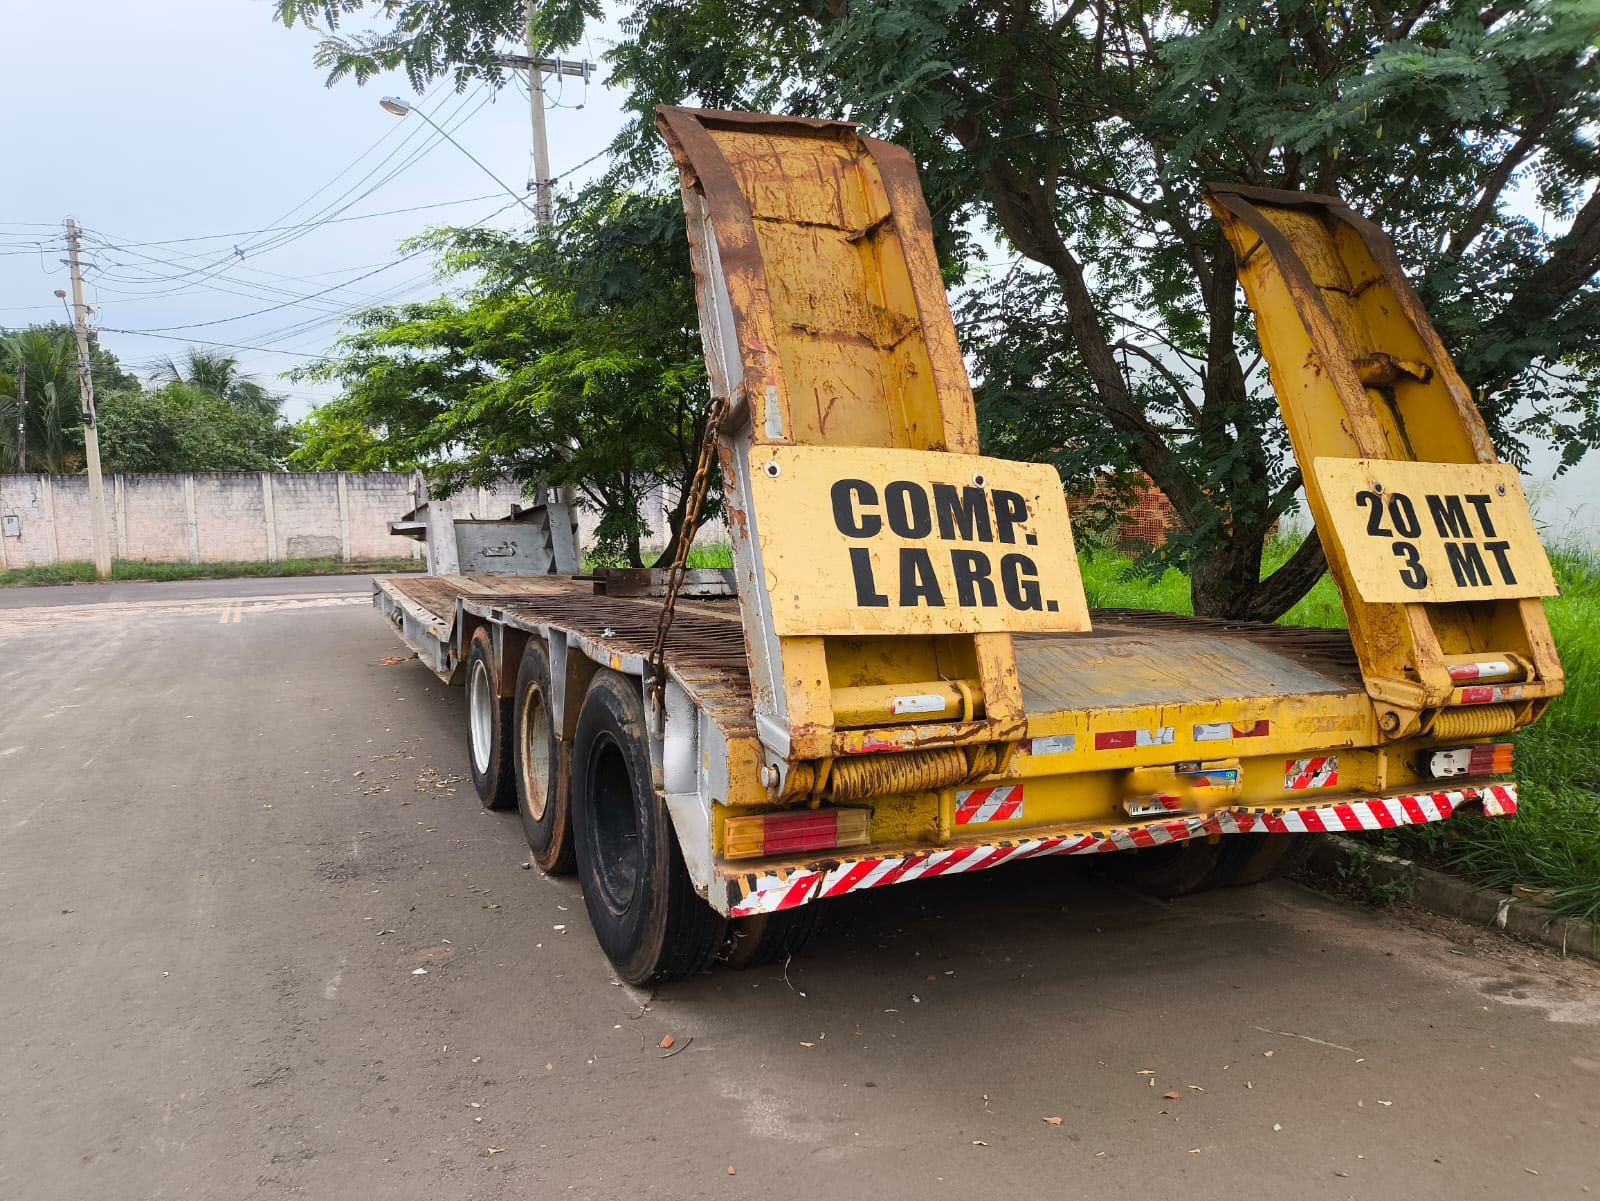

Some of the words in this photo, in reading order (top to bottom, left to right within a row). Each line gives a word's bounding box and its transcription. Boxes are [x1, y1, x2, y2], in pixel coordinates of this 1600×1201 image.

[830, 478, 1038, 546] COMP.
[1356, 490, 1422, 539] 20
[1425, 494, 1497, 539] MT
[848, 547, 1060, 612] LARG.
[1392, 541, 1428, 590] 3
[1444, 541, 1518, 588] MT
